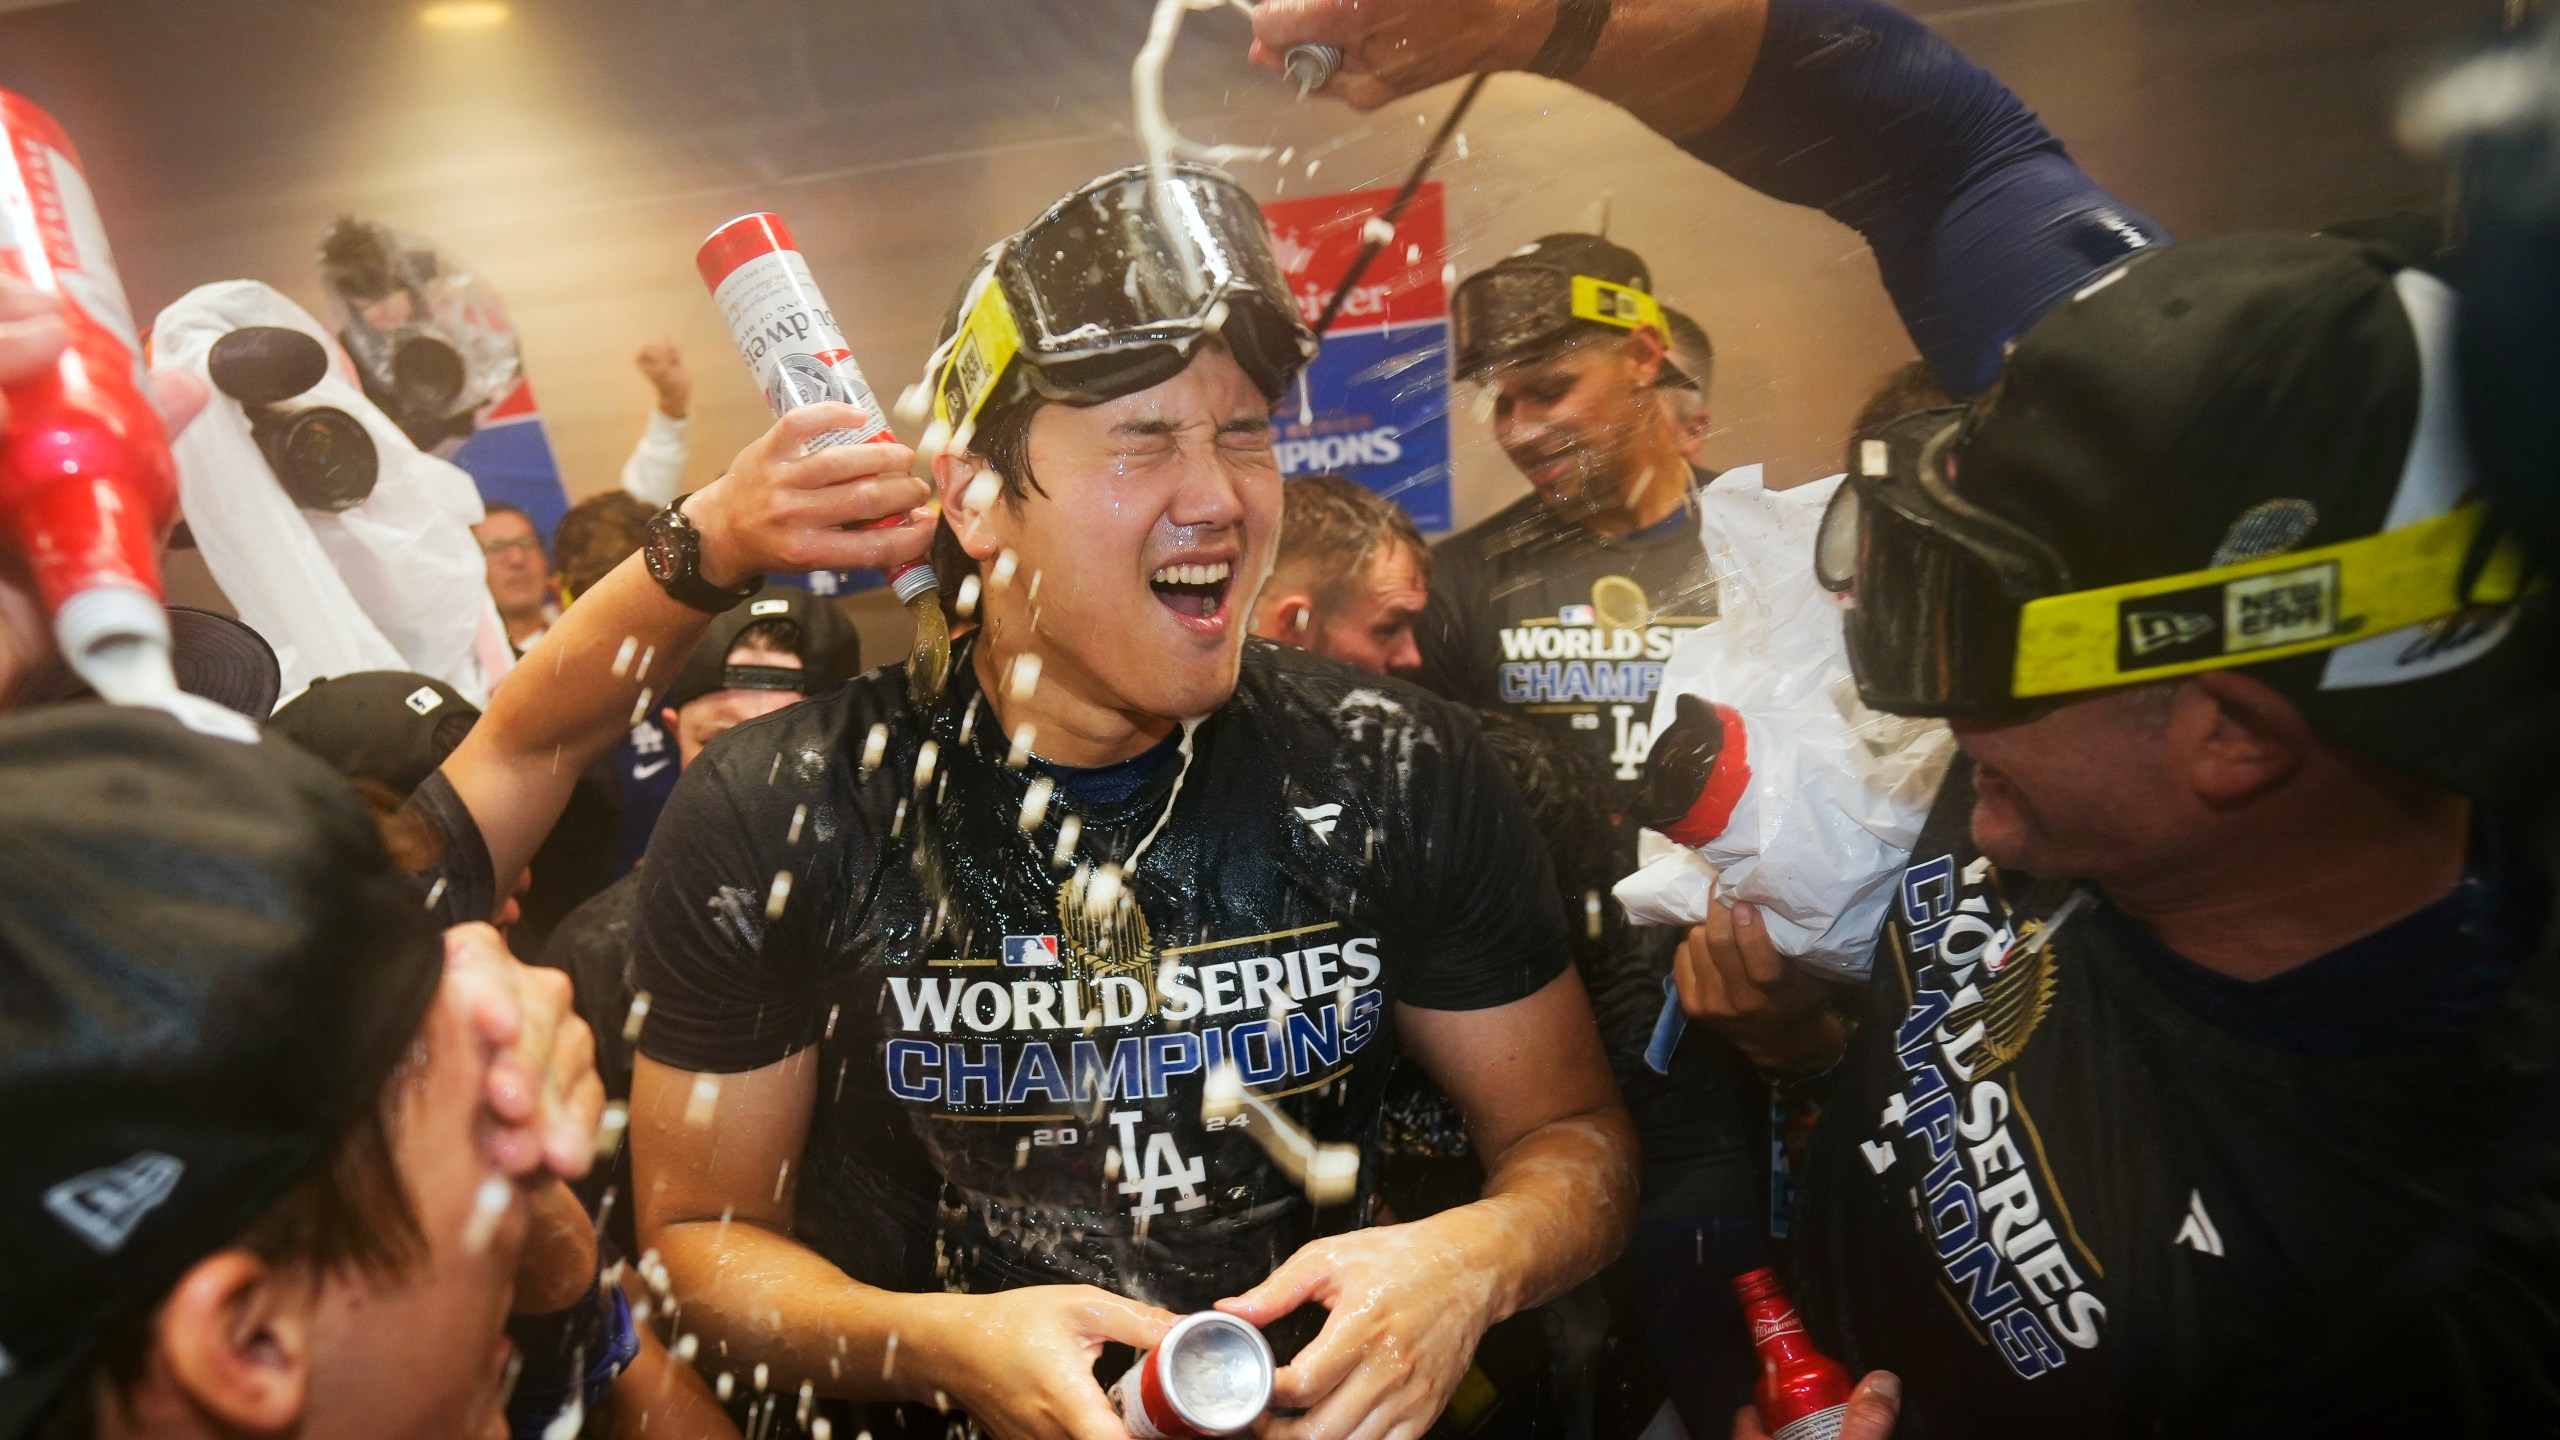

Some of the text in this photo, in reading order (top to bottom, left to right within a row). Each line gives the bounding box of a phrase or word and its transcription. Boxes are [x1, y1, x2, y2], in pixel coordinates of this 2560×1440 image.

[757, 311, 773, 325] OF
[2241, 581, 2324, 611] NEW
[2241, 601, 2324, 637] ERA
[1499, 627, 1643, 661] WORLD
[886, 937, 1382, 1034] WORLD SERIES
[885, 988, 1384, 1105] CHAMPIONS
[1033, 1110, 1251, 1218] 20 LA 24
[1956, 1079, 2108, 1351] SERIES
